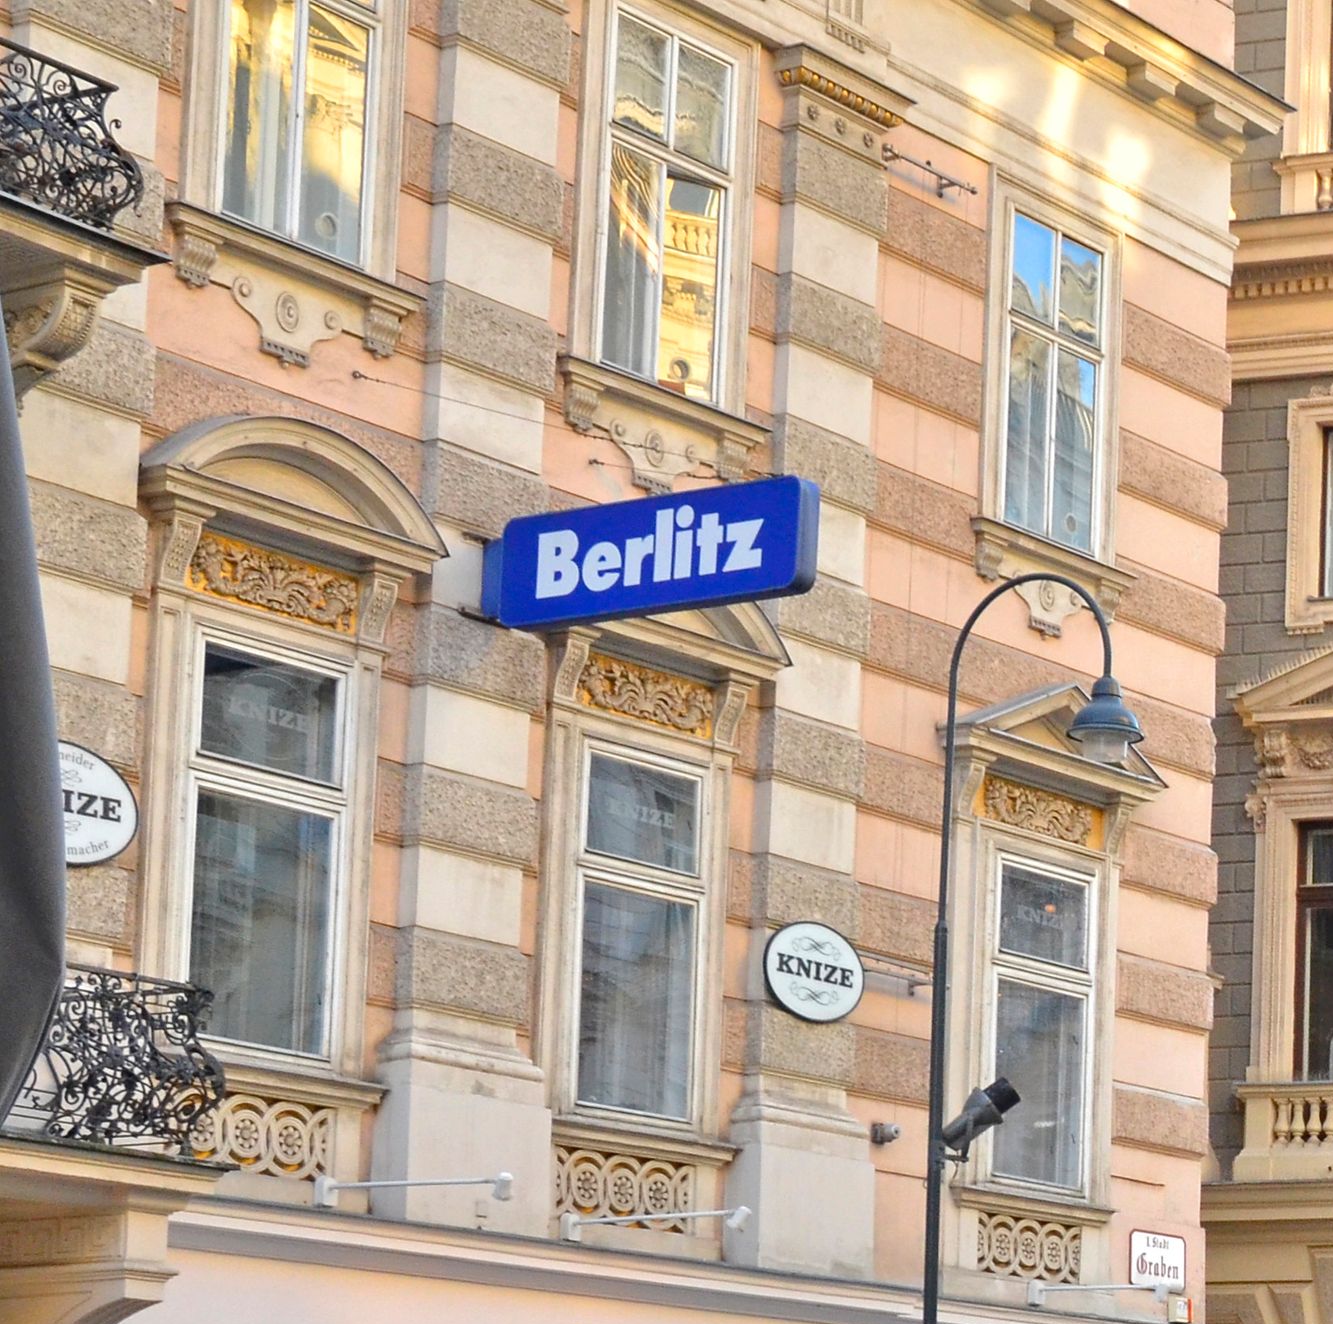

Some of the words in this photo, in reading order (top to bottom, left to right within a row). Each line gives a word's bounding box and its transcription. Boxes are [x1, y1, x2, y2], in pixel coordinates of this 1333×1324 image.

[535, 505, 764, 599] Berlitz
[59, 750, 95, 771] neider
[62, 789, 122, 823] IZE
[66, 840, 109, 856] macher
[776, 953, 854, 989] KNIZE
[1136, 1252, 1179, 1280] Graben
